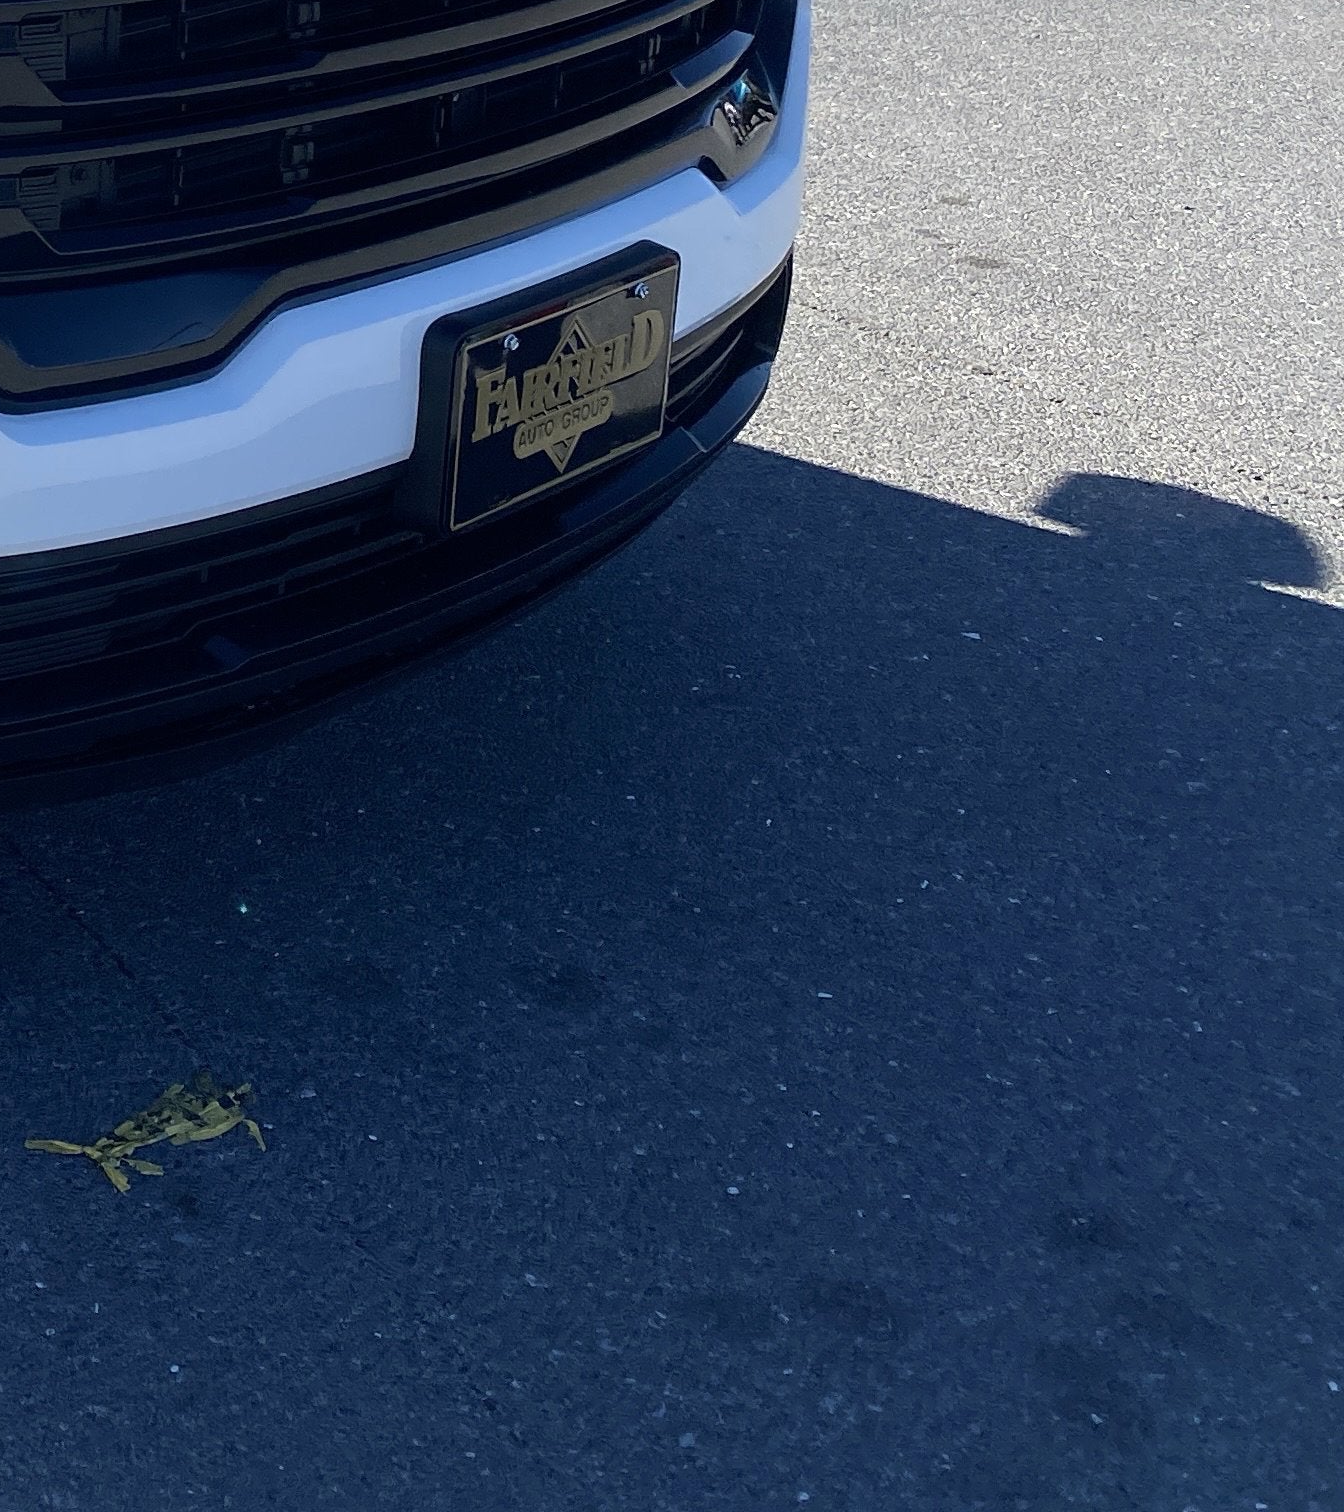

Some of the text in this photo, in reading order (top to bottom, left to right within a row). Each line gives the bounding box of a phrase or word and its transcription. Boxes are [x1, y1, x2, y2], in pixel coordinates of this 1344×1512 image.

[471, 309, 664, 443] FAIRFIELD
[518, 394, 610, 448] AUTO GROUP
